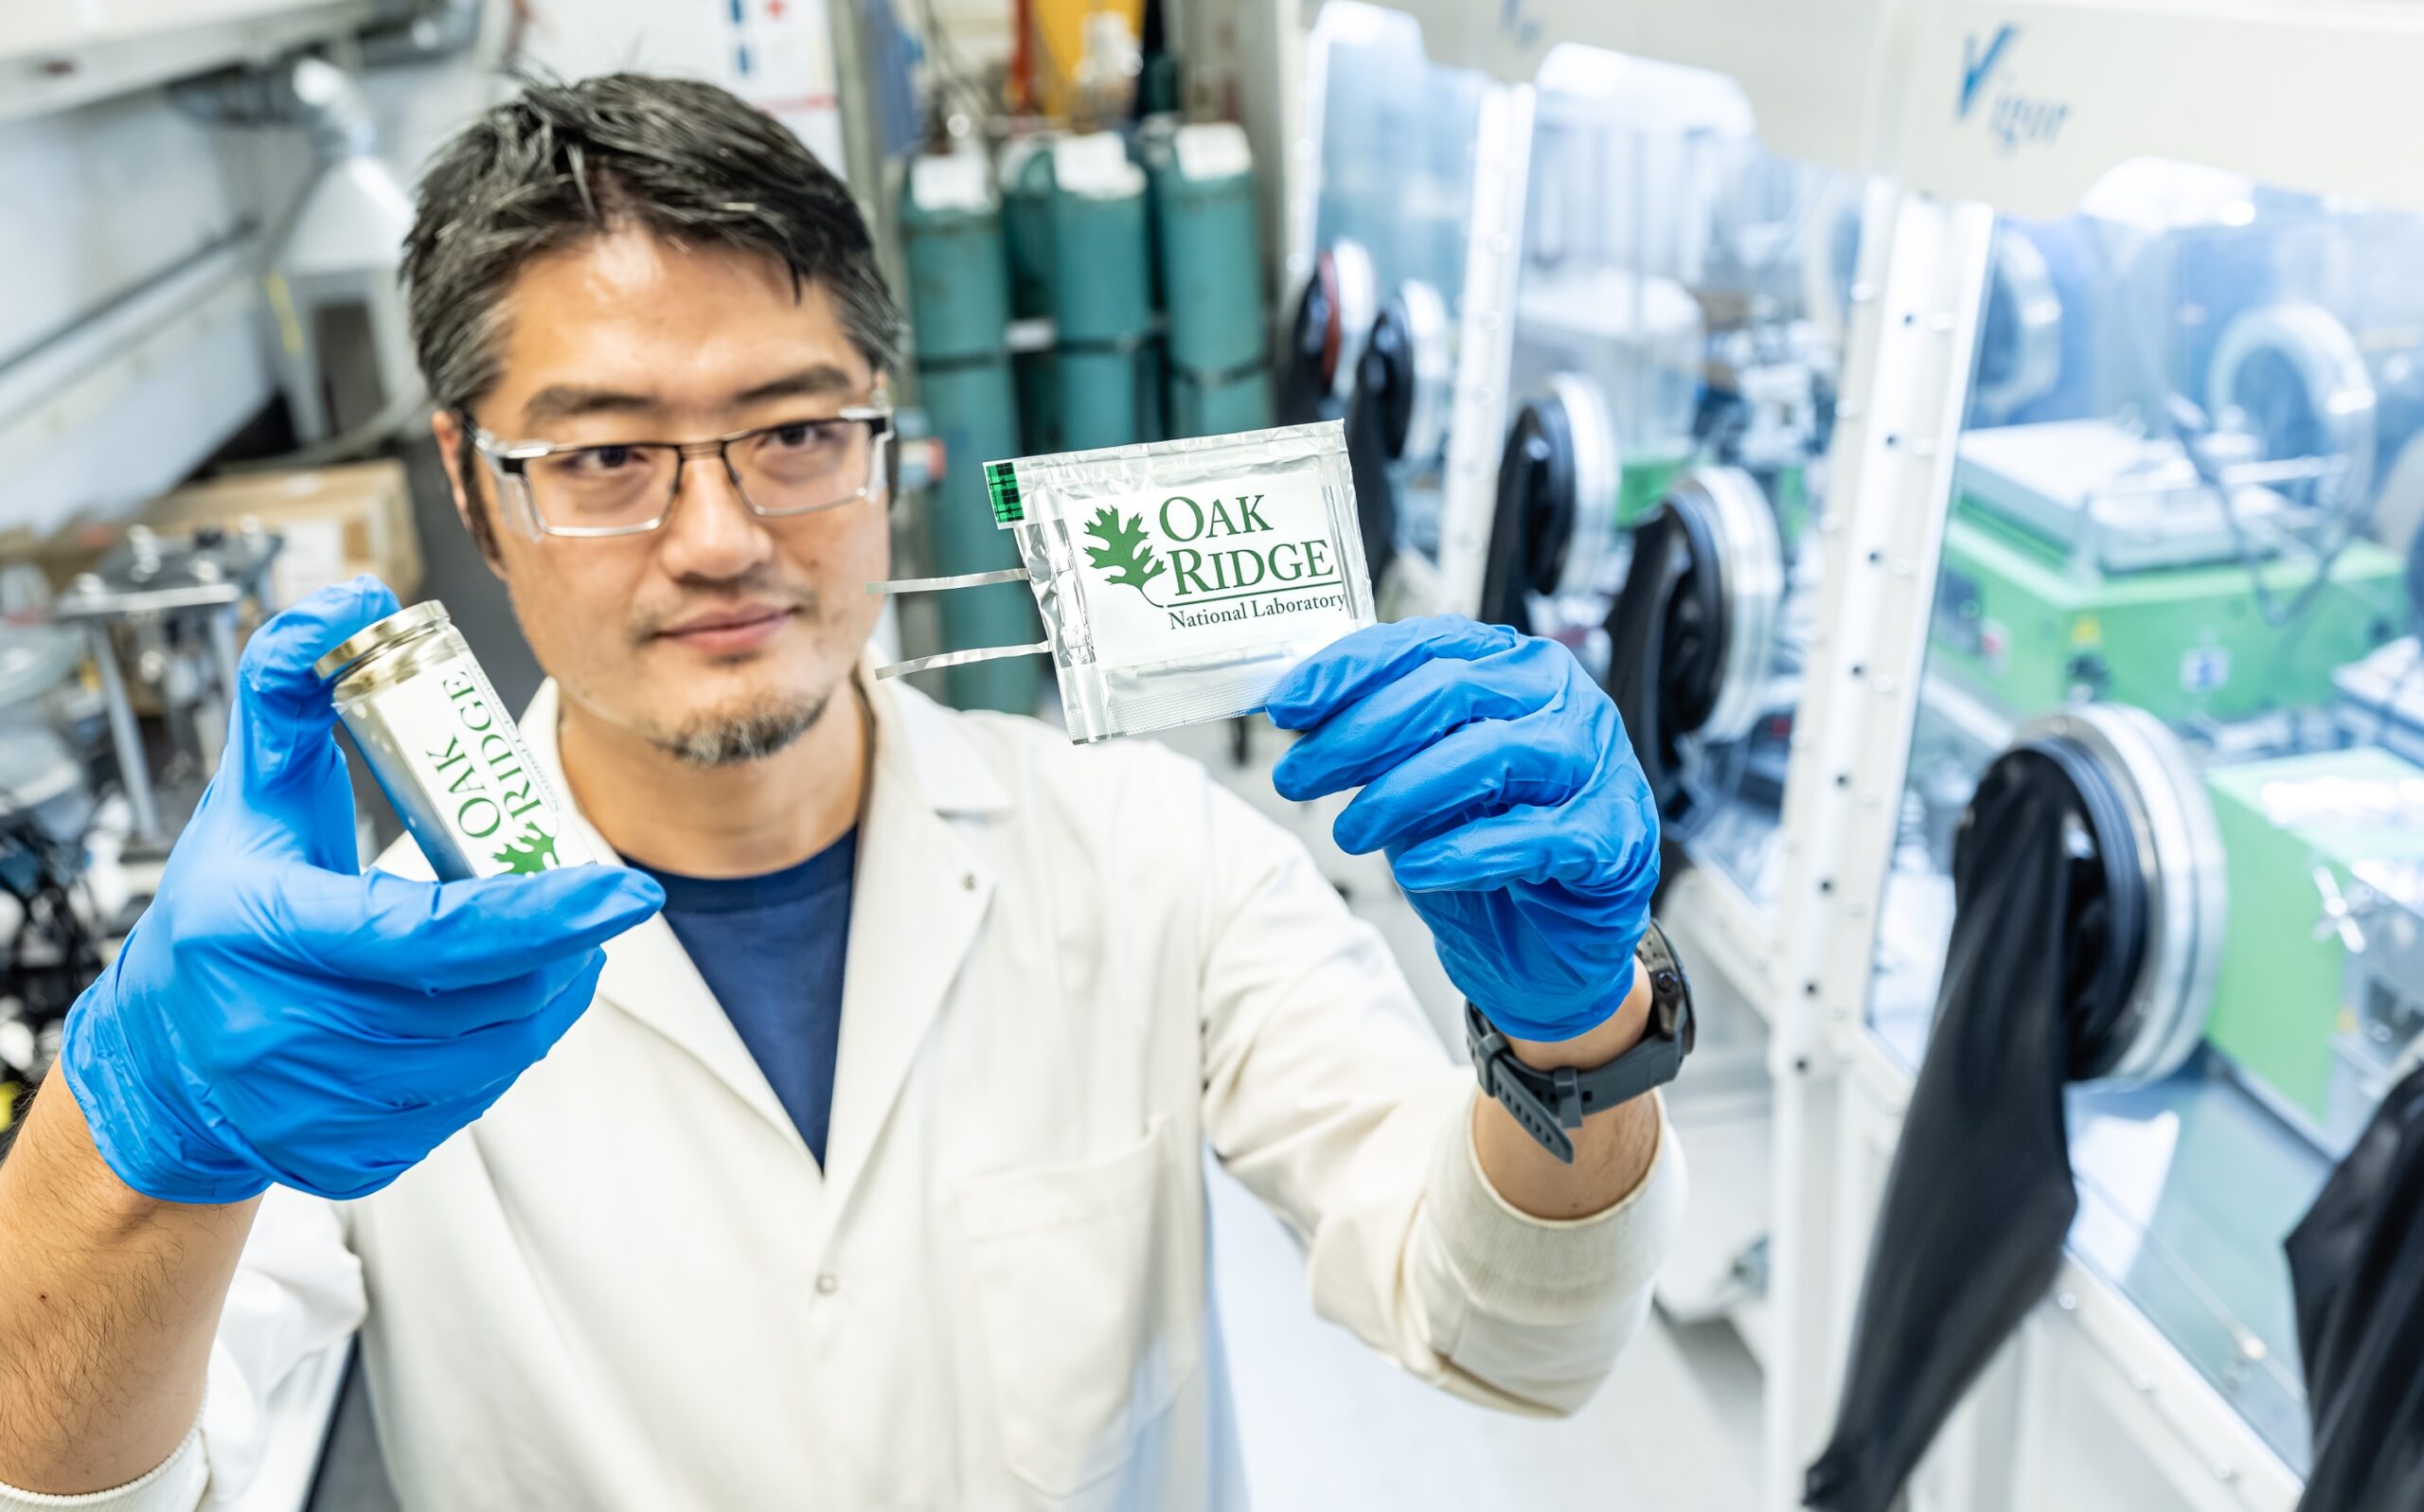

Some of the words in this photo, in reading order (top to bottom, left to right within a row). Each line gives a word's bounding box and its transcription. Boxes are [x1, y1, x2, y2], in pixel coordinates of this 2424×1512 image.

[1159, 495, 1274, 543] OAK
[1167, 540, 1333, 596] RIDGE
[1167, 602, 1247, 630] National
[1250, 594, 1346, 618] Laboratory
[442, 670, 543, 819] RIDGE
[425, 733, 501, 839] OAK
